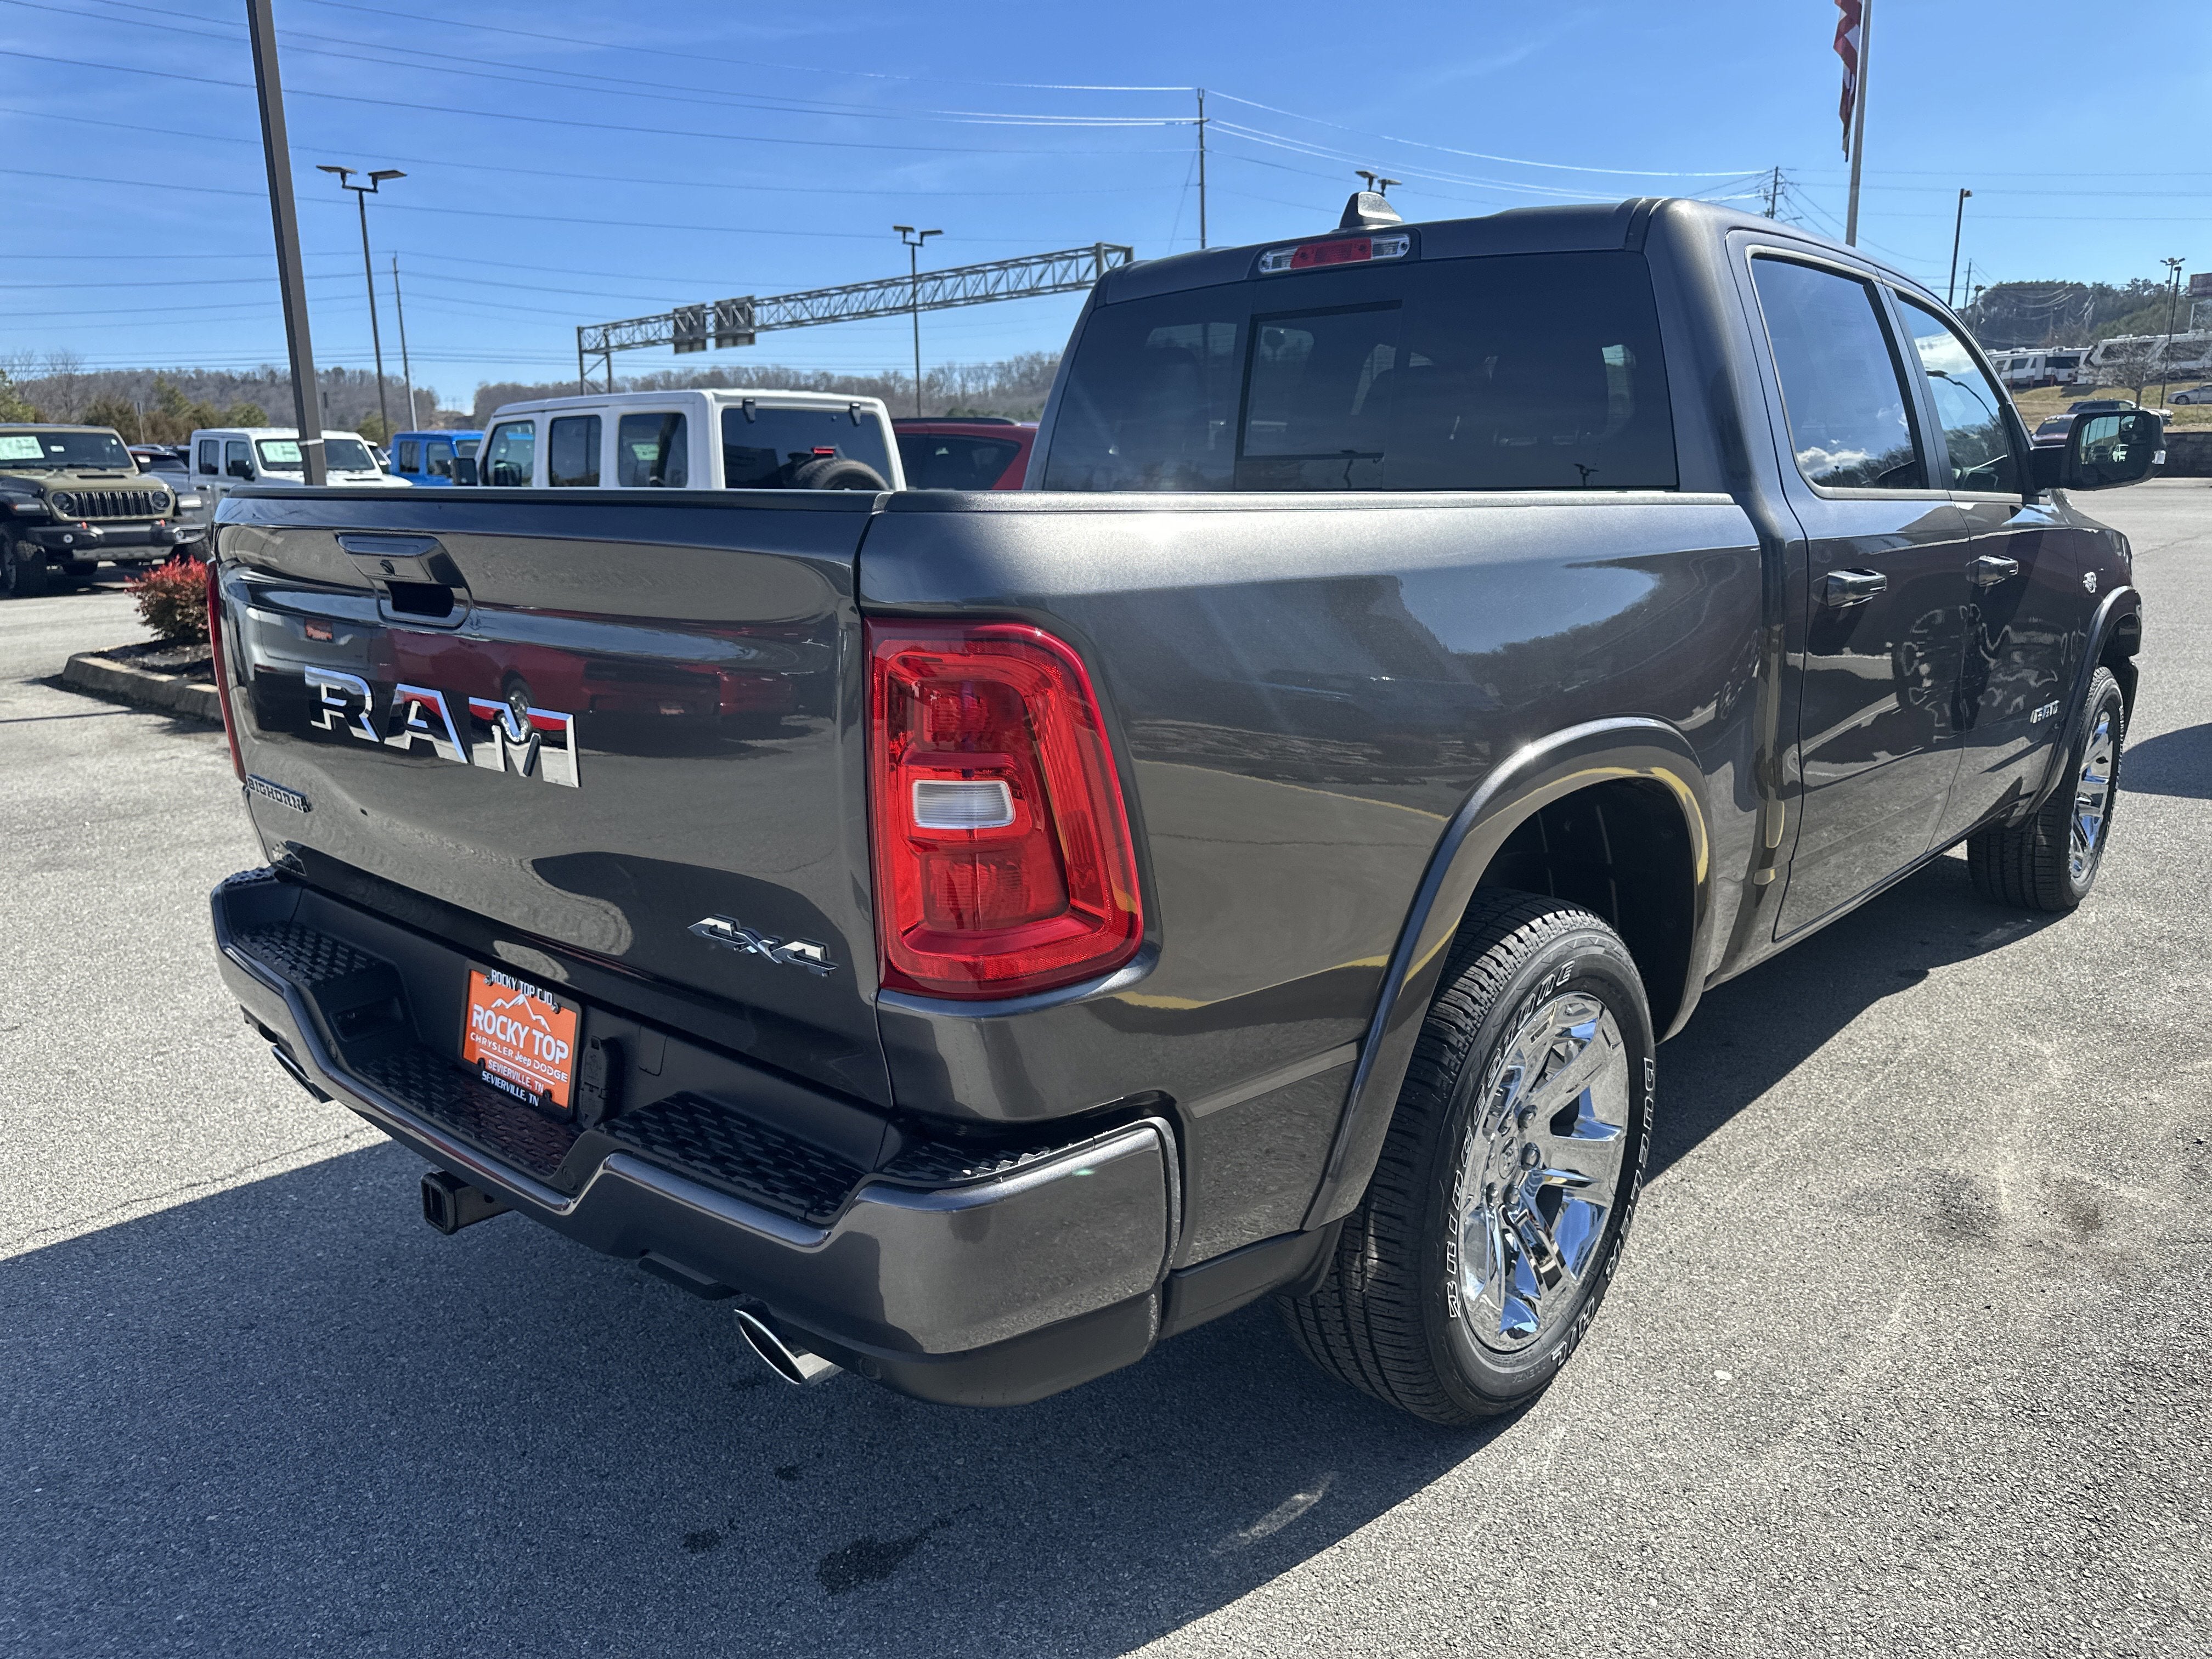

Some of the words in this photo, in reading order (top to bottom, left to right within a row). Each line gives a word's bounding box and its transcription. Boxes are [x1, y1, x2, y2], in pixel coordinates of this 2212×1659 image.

[304, 665, 580, 788] RAM
[492, 969, 517, 991] ROCKY
[520, 980, 535, 997] TOP
[470, 1032, 514, 1058] CHRYSLER
[515, 1051, 532, 1067] Jeep
[533, 1059, 568, 1083] DODGE
[472, 1003, 530, 1049] ROCKY
[532, 1029, 569, 1065] TOP
[482, 1070, 527, 1102] SEVIERVILLE,
[529, 1093, 539, 1107] TN
[488, 1059, 532, 1090] SEVIERVILLE,
[534, 1080, 544, 1093] TN
[1606, 1057, 1656, 1281] DUELER
